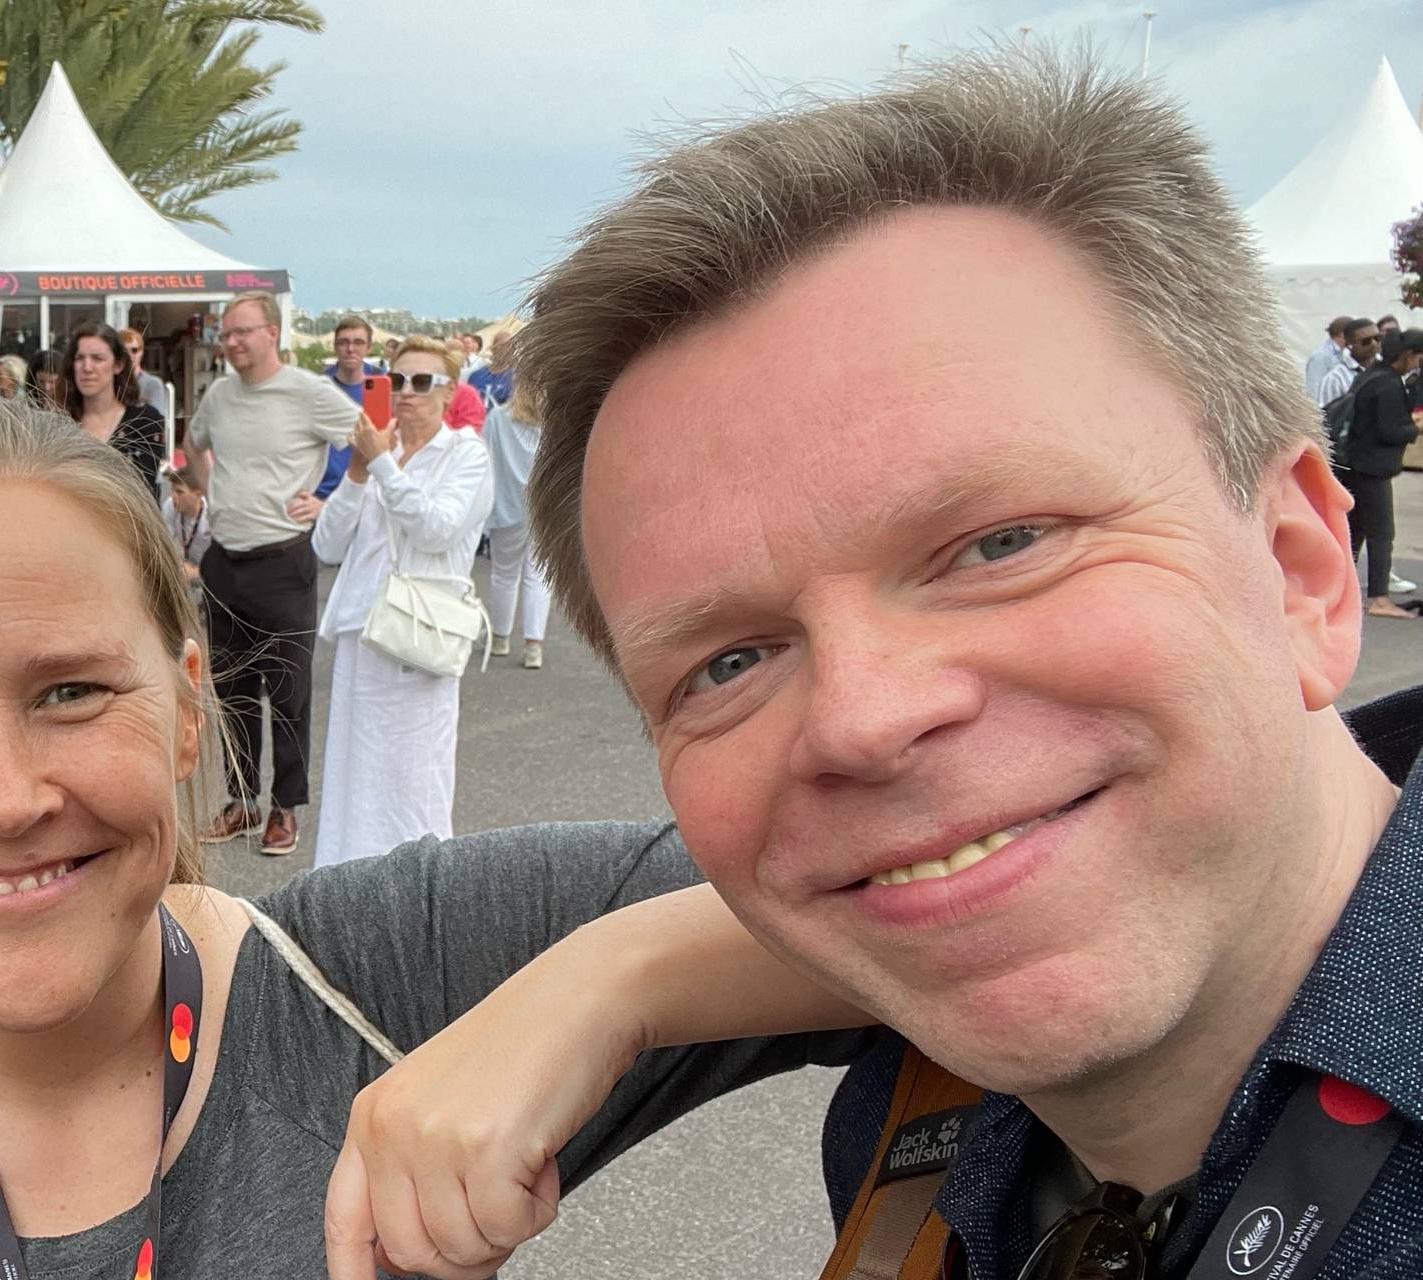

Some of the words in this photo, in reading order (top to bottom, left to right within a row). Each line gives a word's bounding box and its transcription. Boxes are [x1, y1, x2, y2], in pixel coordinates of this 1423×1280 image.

[38, 274, 118, 292] BOUTIQUE
[120, 272, 206, 290] OFFICIELLE
[892, 1127, 932, 1152] Jack
[888, 1142, 959, 1170] Wolfskin
[1280, 1243, 1295, 1259] DE
[1289, 1203, 1319, 1244] CANNES
[1298, 1218, 1325, 1251] OFFICIEL
